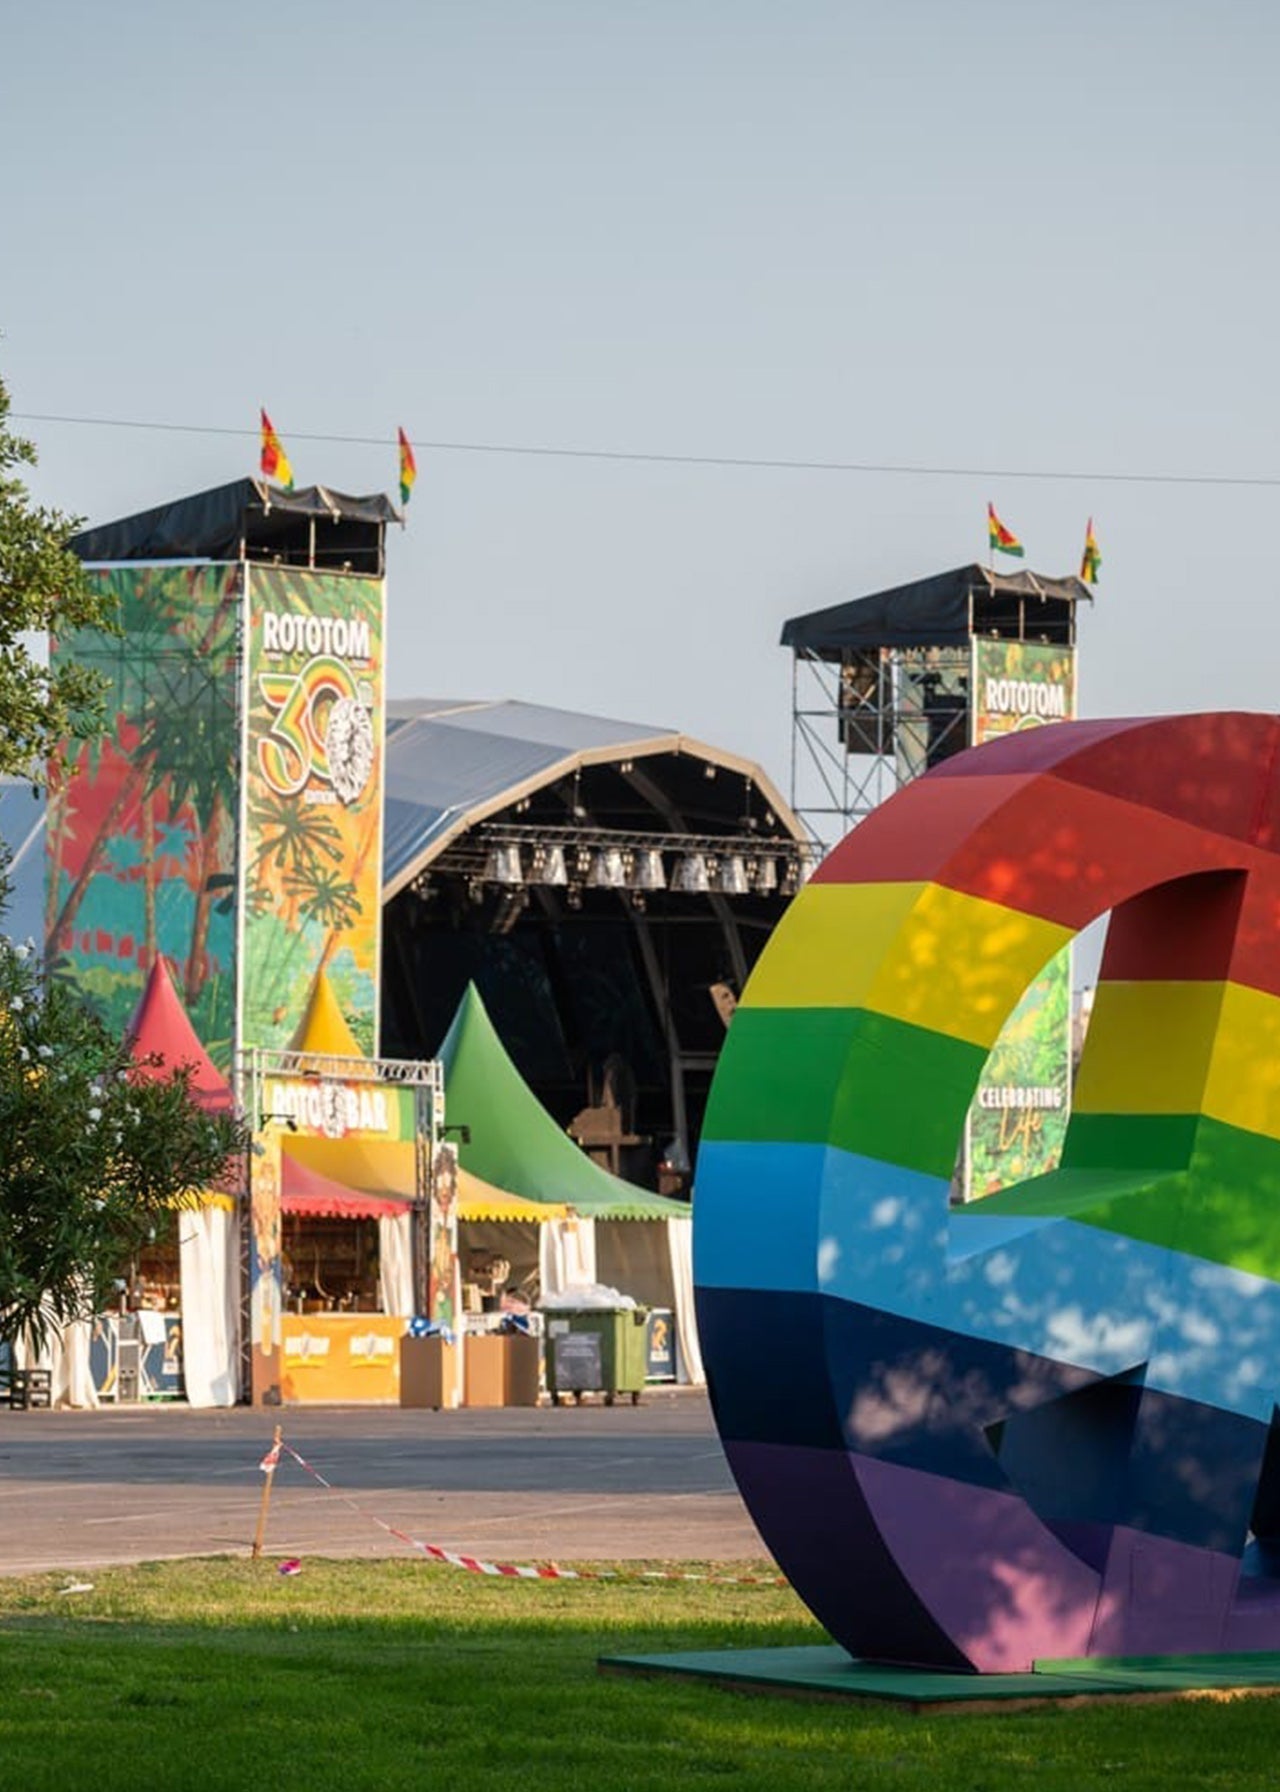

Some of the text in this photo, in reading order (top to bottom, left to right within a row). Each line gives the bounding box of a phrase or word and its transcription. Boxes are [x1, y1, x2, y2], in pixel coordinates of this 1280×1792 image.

[263, 612, 370, 658] ROTOTOM
[985, 677, 1064, 717] ROTOTOM
[272, 1083, 388, 1131] ROTO BAR
[979, 1086, 1062, 1108] CELEBRATING
